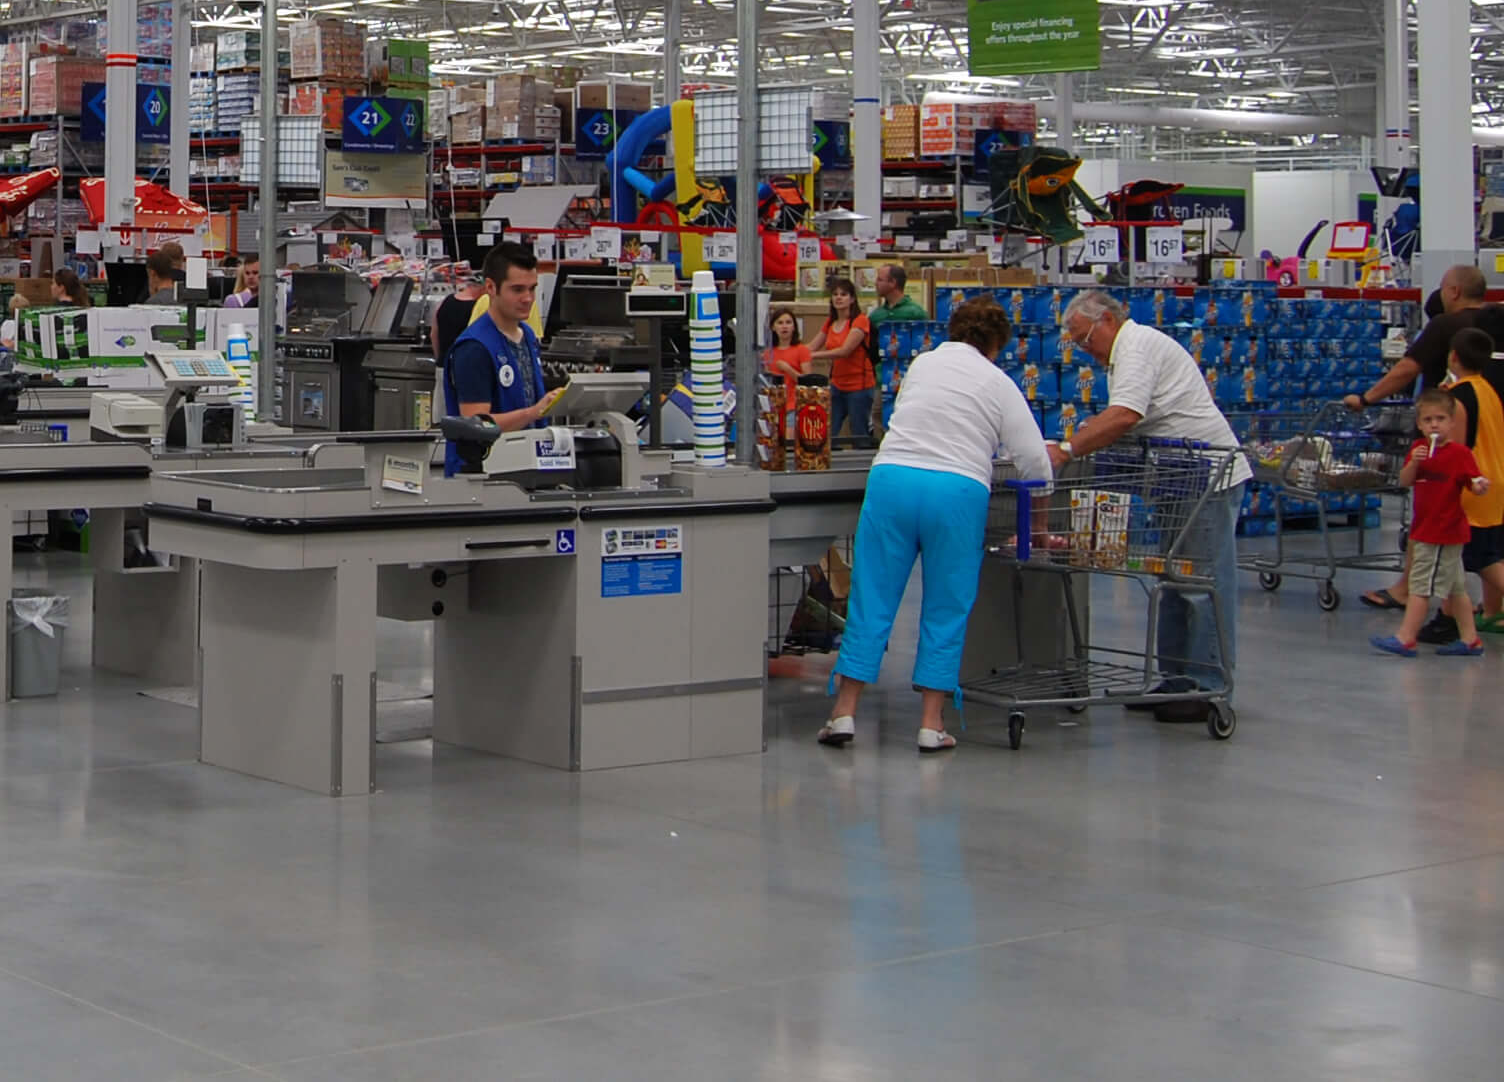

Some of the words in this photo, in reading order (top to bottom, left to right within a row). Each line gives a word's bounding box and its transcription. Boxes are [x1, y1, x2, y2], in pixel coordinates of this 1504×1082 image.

[151, 100, 161, 114] 20
[361, 111, 378, 125] 21
[405, 113, 416, 126] 22
[594, 122, 609, 135] 23
[1193, 202, 1231, 219] Foods
